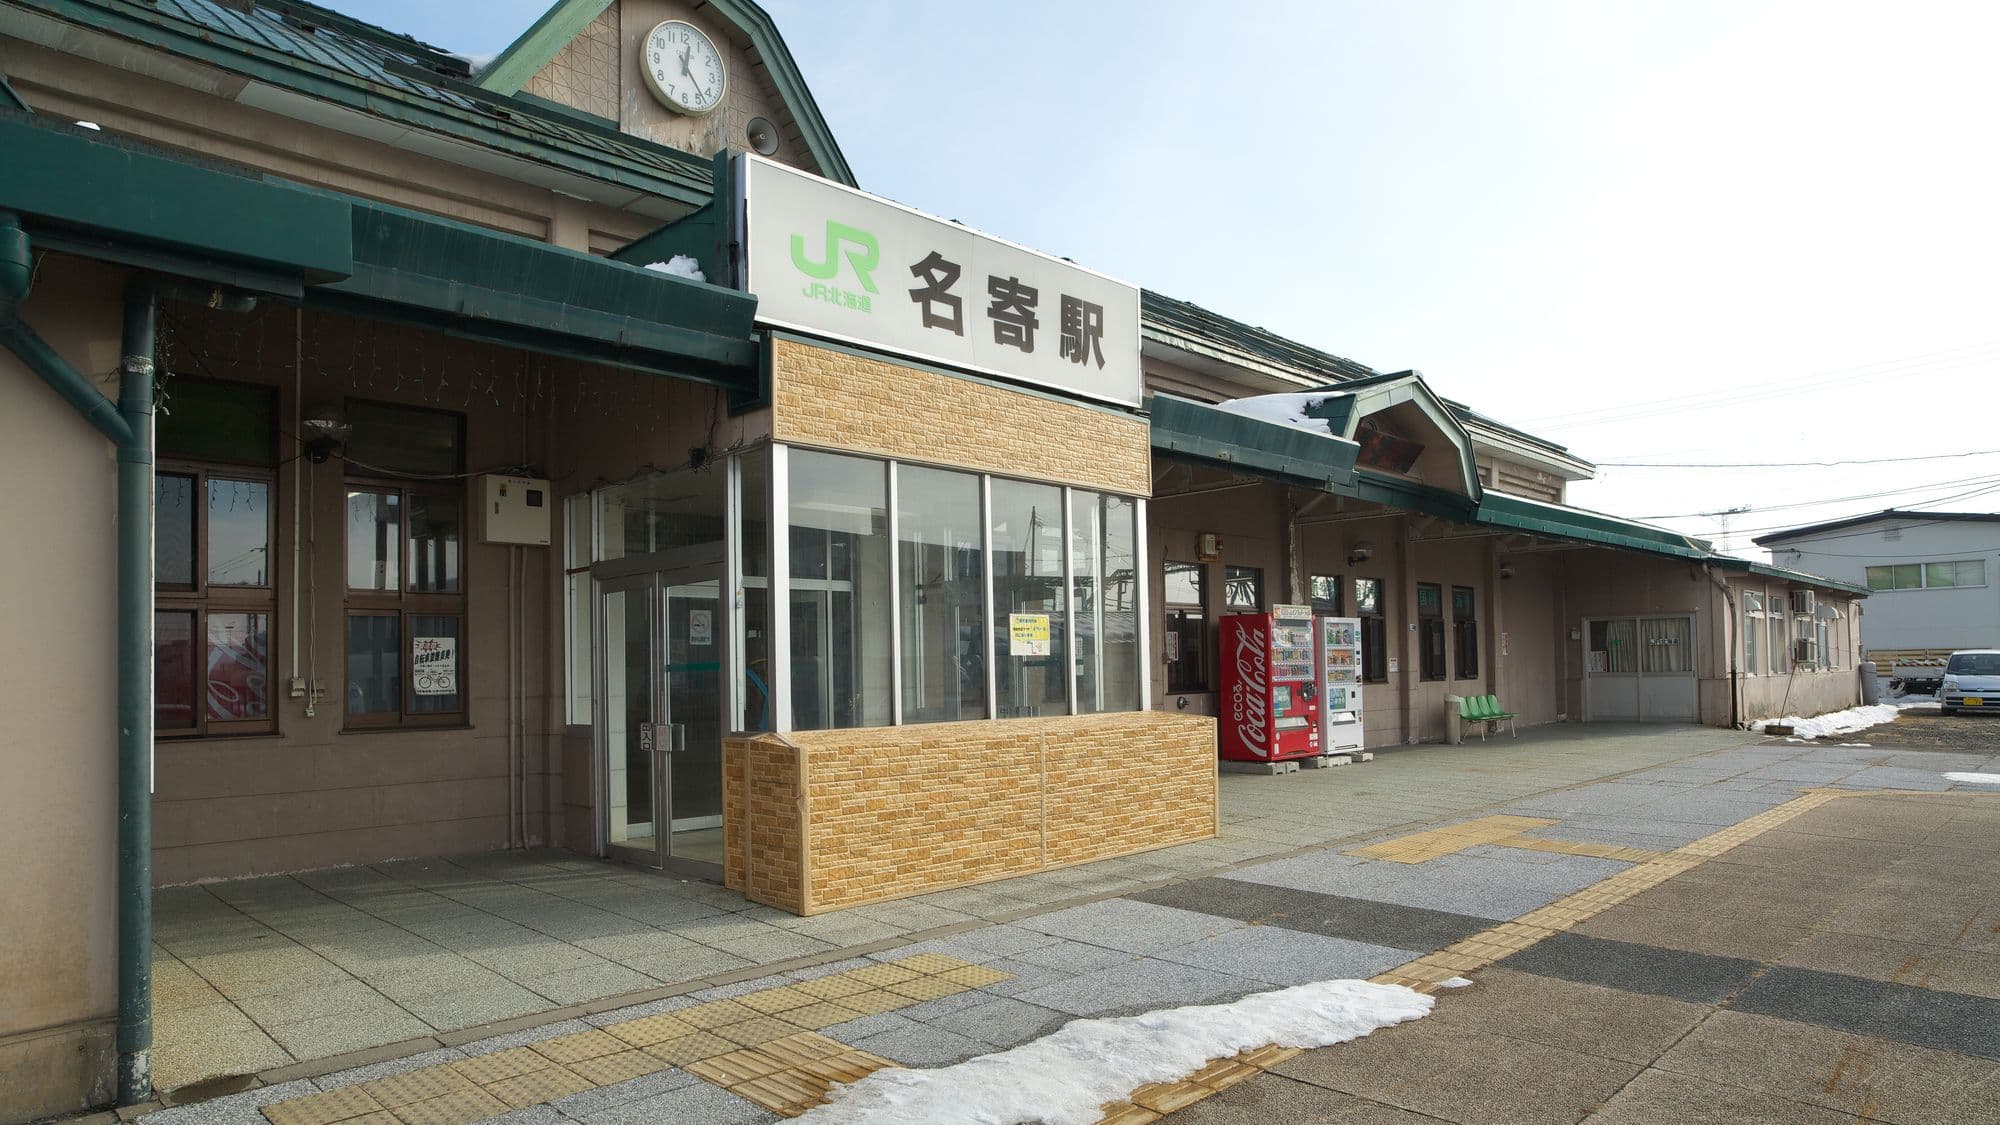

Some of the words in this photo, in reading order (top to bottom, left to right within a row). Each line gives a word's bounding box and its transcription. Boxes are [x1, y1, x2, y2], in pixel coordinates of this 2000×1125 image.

[656, 36, 666, 49] 10
[668, 30, 676, 43] 11
[680, 31, 690, 45] 12
[653, 52, 661, 64] 9
[704, 55, 712, 67] 2
[657, 69, 665, 81] 8
[708, 72, 716, 84] 3
[668, 84, 675, 96] 7
[704, 86, 712, 98] 4
[681, 92, 689, 104] 6
[694, 93, 702, 105] 5
[791, 219, 880, 295] JR
[802, 282, 872, 313] JR北海道
[908, 250, 1106, 371] 名寄駅
[1236, 620, 1267, 758] Coca-Cola
[642, 723, 651, 750] 出入口
